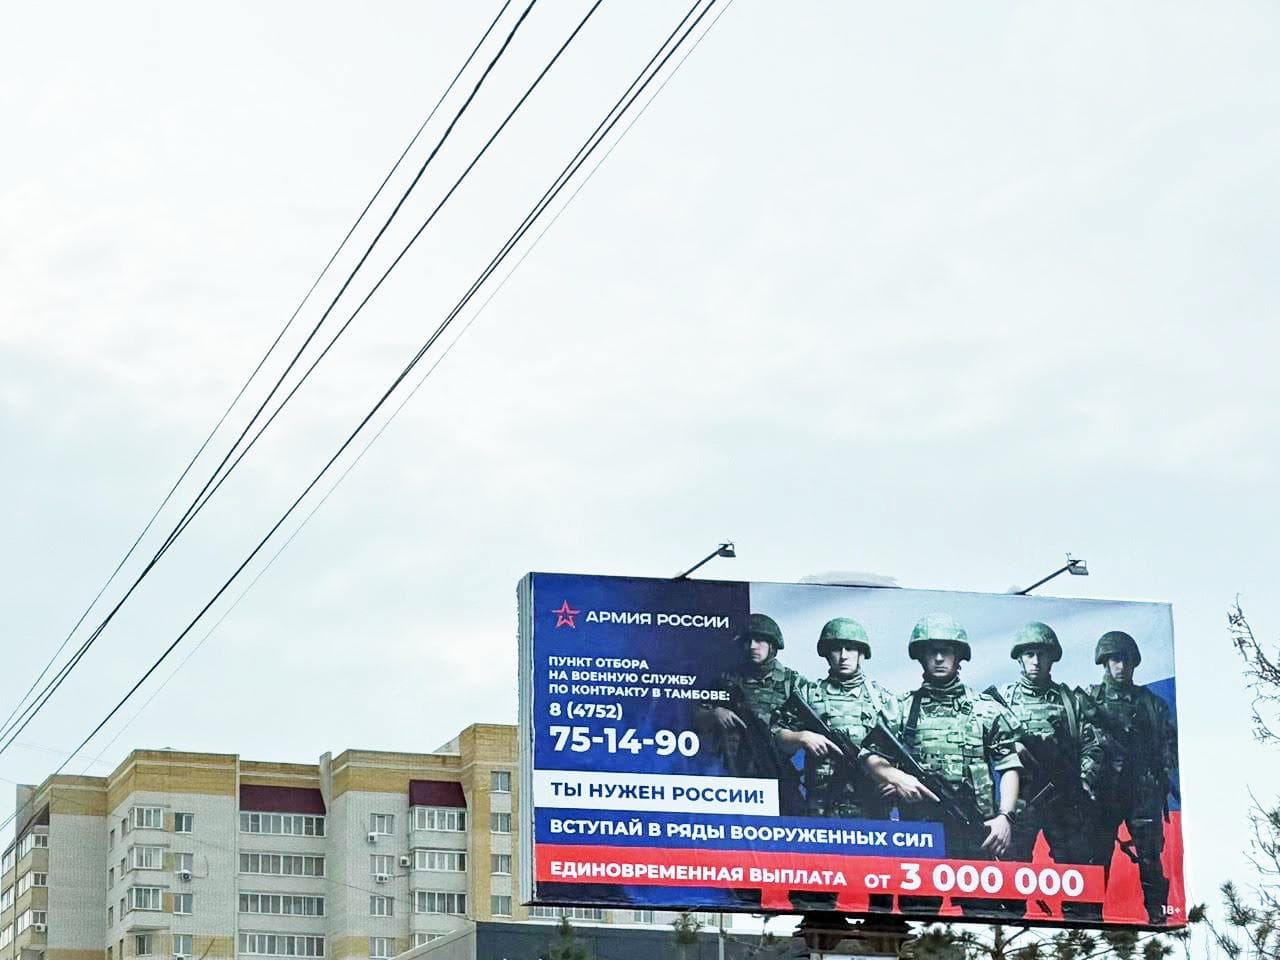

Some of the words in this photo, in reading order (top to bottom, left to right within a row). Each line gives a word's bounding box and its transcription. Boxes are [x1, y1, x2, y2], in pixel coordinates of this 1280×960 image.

[586, 610, 652, 625] АРМИЯ
[657, 612, 730, 629] РОССИИ
[549, 656, 592, 668] ПУНКТ
[596, 658, 649, 670] ОТБОРА
[549, 670, 568, 681] НА
[571, 671, 638, 684] ВОЕННУЮ
[641, 674, 696, 686] СЛУЖБУ
[549, 684, 568, 695] ПО
[571, 685, 648, 699] КОНТРАКТУ
[653, 688, 661, 698] В
[664, 688, 730, 701] ТАМБОВЕ:
[549, 703, 561, 717] 8
[567, 701, 623, 720] (4752)
[549, 726, 700, 757] 75-14-90
[551, 782, 582, 797] ТЫ
[589, 783, 665, 800] НУЖЕН
[672, 786, 764, 804] РОССИИ!
[550, 819, 642, 837] ВСТУПАЙ
[648, 822, 661, 838] В
[667, 823, 724, 840] РЯДЫ
[730, 825, 887, 846] ВООРУЖЕННЫХ
[892, 832, 933, 848] СИЛ
[550, 861, 743, 882] ЕДИНОВРЕМЕННАЯ
[749, 867, 847, 886] ВЫПЛАТА
[900, 862, 921, 890] 3
[932, 864, 1003, 893] 000
[1014, 866, 1084, 896] 000
[1161, 905, 1181, 915] 18+
